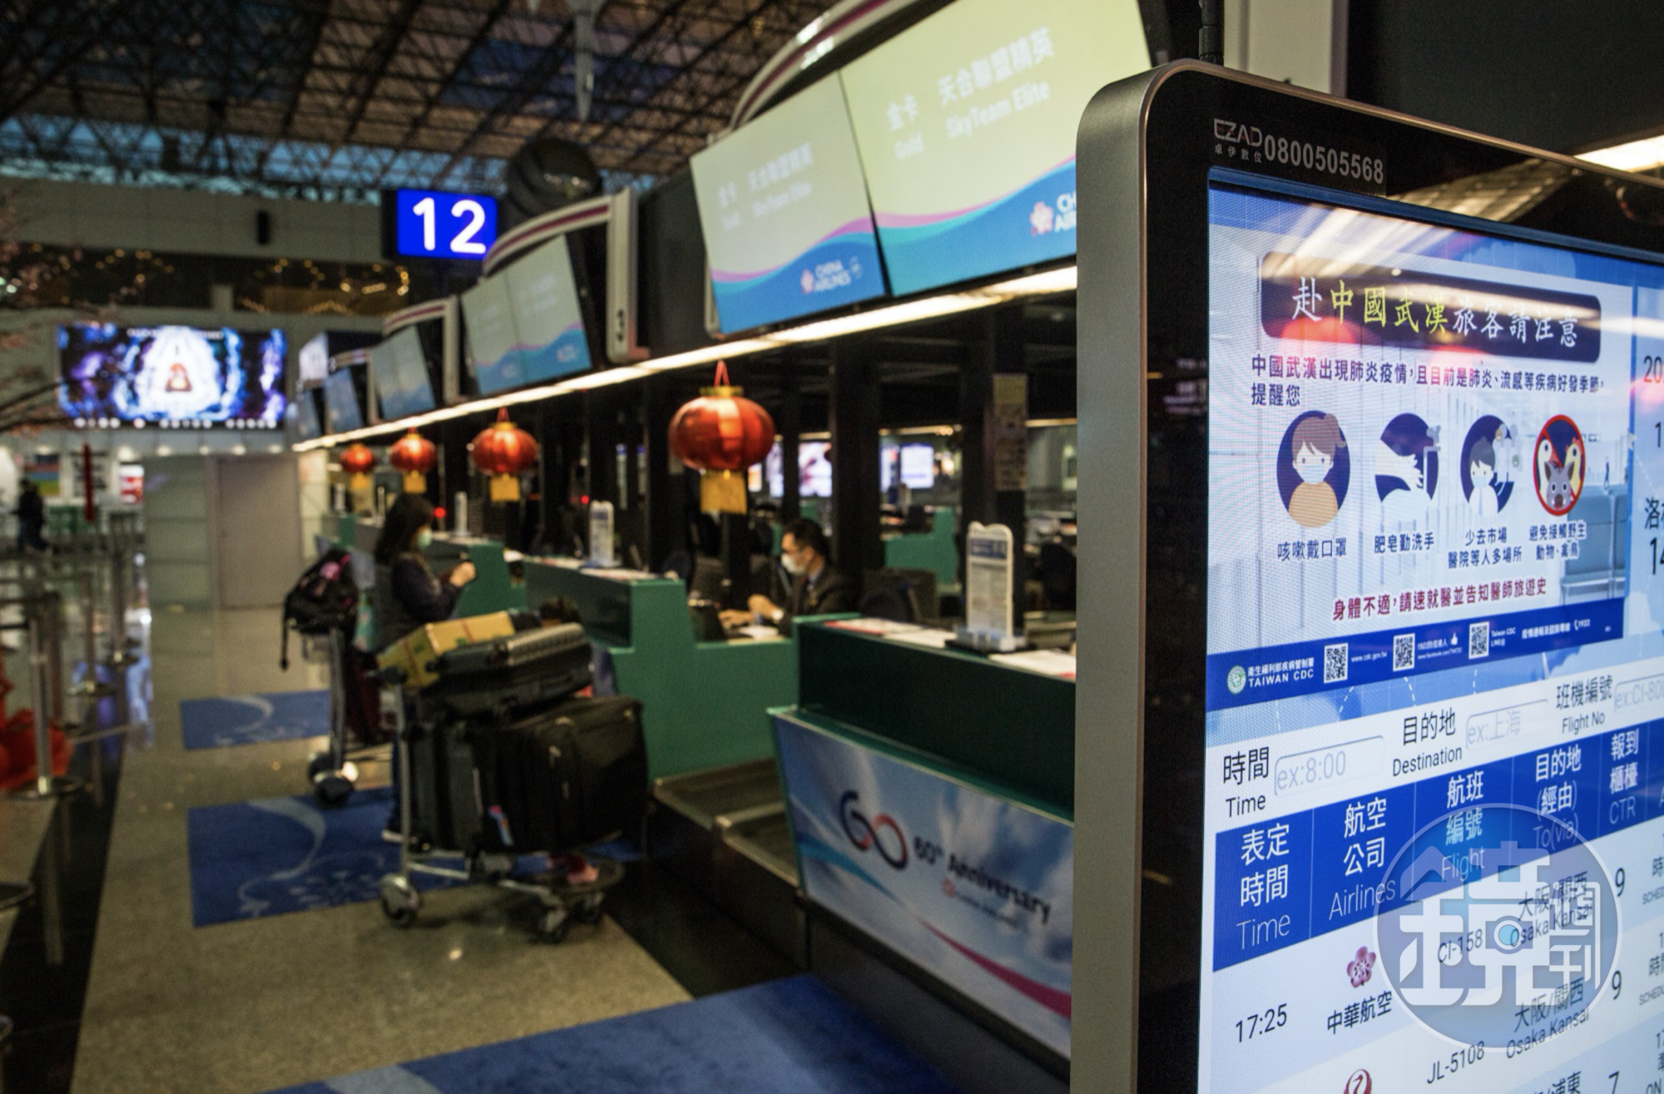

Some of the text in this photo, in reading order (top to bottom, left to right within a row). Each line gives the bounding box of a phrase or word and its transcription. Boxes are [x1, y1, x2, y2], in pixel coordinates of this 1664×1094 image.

[1264, 135, 1383, 184] 0800505568
[412, 197, 487, 254] 12
[1292, 276, 1578, 347] 赴中國武漢旅客請注意
[1252, 382, 1300, 406] 提醒您
[1277, 537, 1346, 562] 咳嗽戴口罩
[1374, 532, 1434, 553] 肥皂勤洗手
[1465, 527, 1507, 546] 少去市場
[1448, 546, 1522, 569] 醫院等人多場所
[1249, 669, 1314, 688] TAIWAN CDC
[1556, 675, 1613, 710] 班機編號
[1403, 707, 1455, 746] 目的地
[1562, 711, 1606, 736] Flight No
[1393, 747, 1462, 777] Destination
[1536, 743, 1582, 783] 目的地
[1611, 728, 1639, 761] 報到
[1223, 747, 1346, 791] 時間 ex:8:00
[1226, 795, 1266, 818] Time
[1446, 770, 1484, 809] 航班
[1537, 779, 1578, 822] (經由)
[1344, 796, 1387, 838] 航空
[1445, 807, 1483, 846] 編號
[1609, 795, 1636, 824] CTR
[1241, 822, 1290, 866] 表定
[1343, 836, 1386, 877] 公司
[1441, 848, 1485, 883] Flight
[1615, 867, 1625, 898] 9
[948, 853, 1051, 926] Anniversary
[1240, 864, 1289, 907] 時間
[1329, 879, 1396, 921] Airlines
[1236, 914, 1291, 950] Time
[1438, 928, 1483, 964] CI-158
[1510, 917, 1549, 948] Osaka
[1514, 976, 1584, 1033] 大阪/關西
[1612, 970, 1622, 1000] 9
[1235, 1003, 1287, 1043] 17:25
[1327, 990, 1392, 1035] 中華航空
[1507, 1005, 1590, 1059] Osaka Kansai
[1427, 1040, 1485, 1084] JL-5108
[1609, 1070, 1620, 1094] 7
